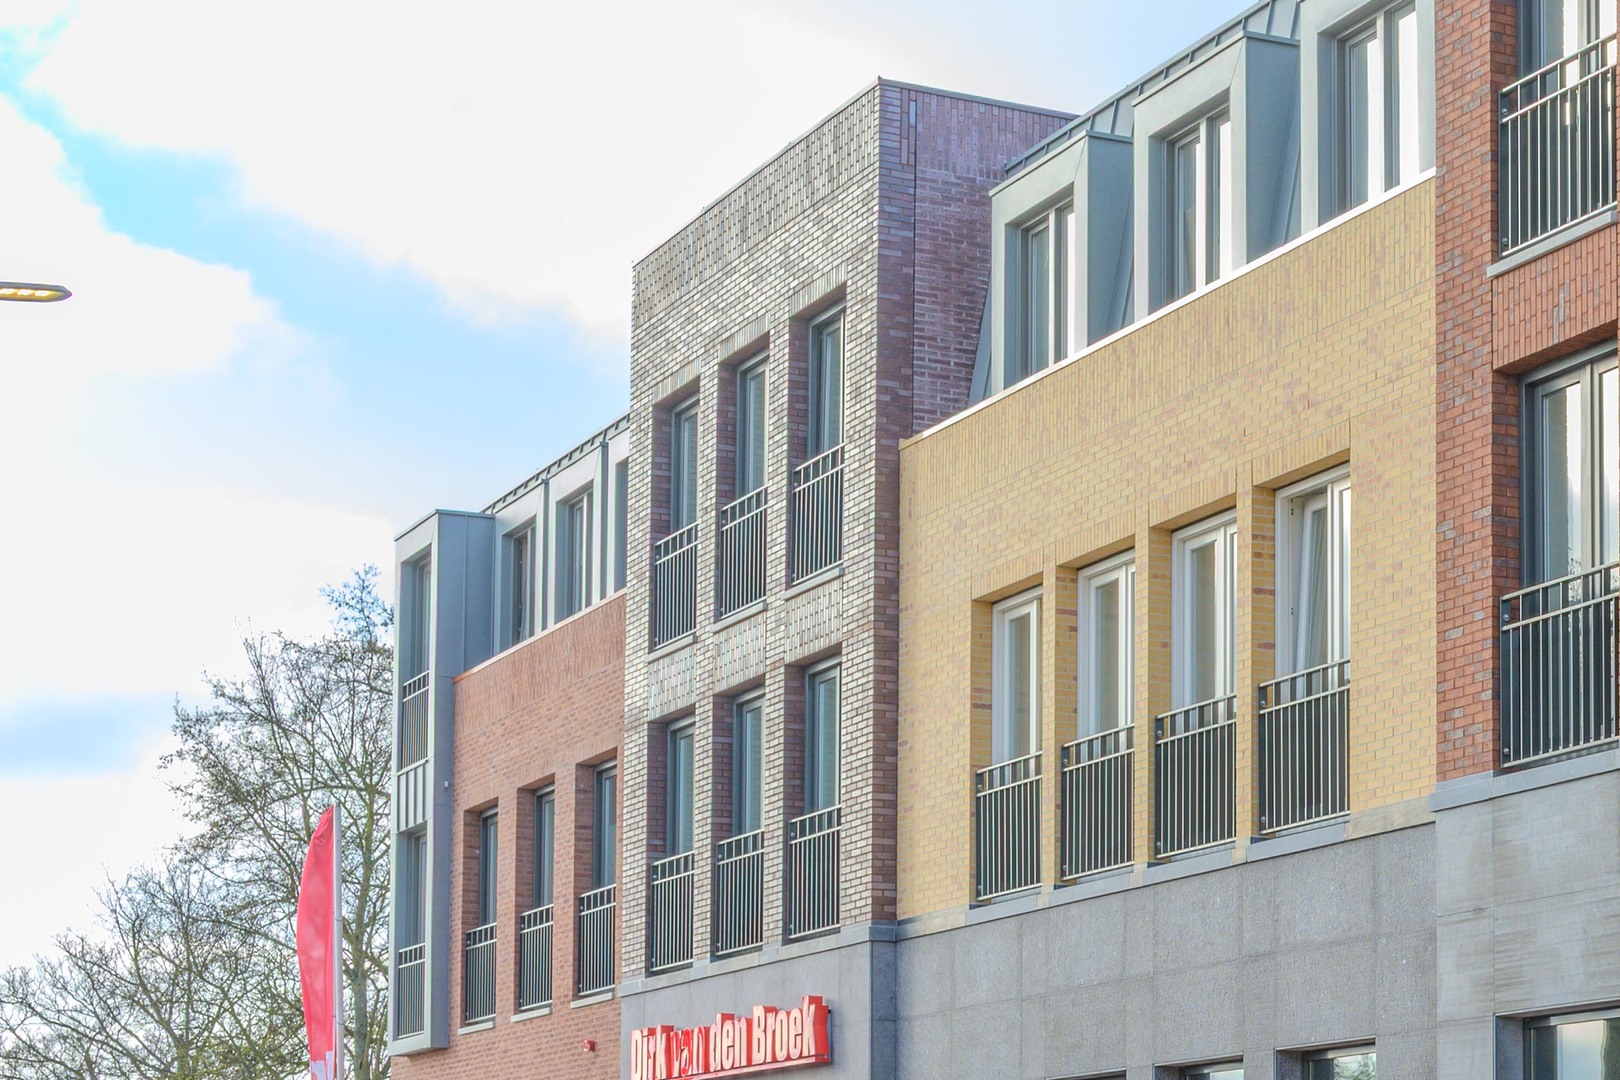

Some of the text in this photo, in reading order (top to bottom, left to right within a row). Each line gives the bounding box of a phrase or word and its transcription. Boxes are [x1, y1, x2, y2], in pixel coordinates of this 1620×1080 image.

[671, 1027, 706, 1078] van
[709, 1013, 747, 1072] den
[753, 996, 820, 1066] Broek
